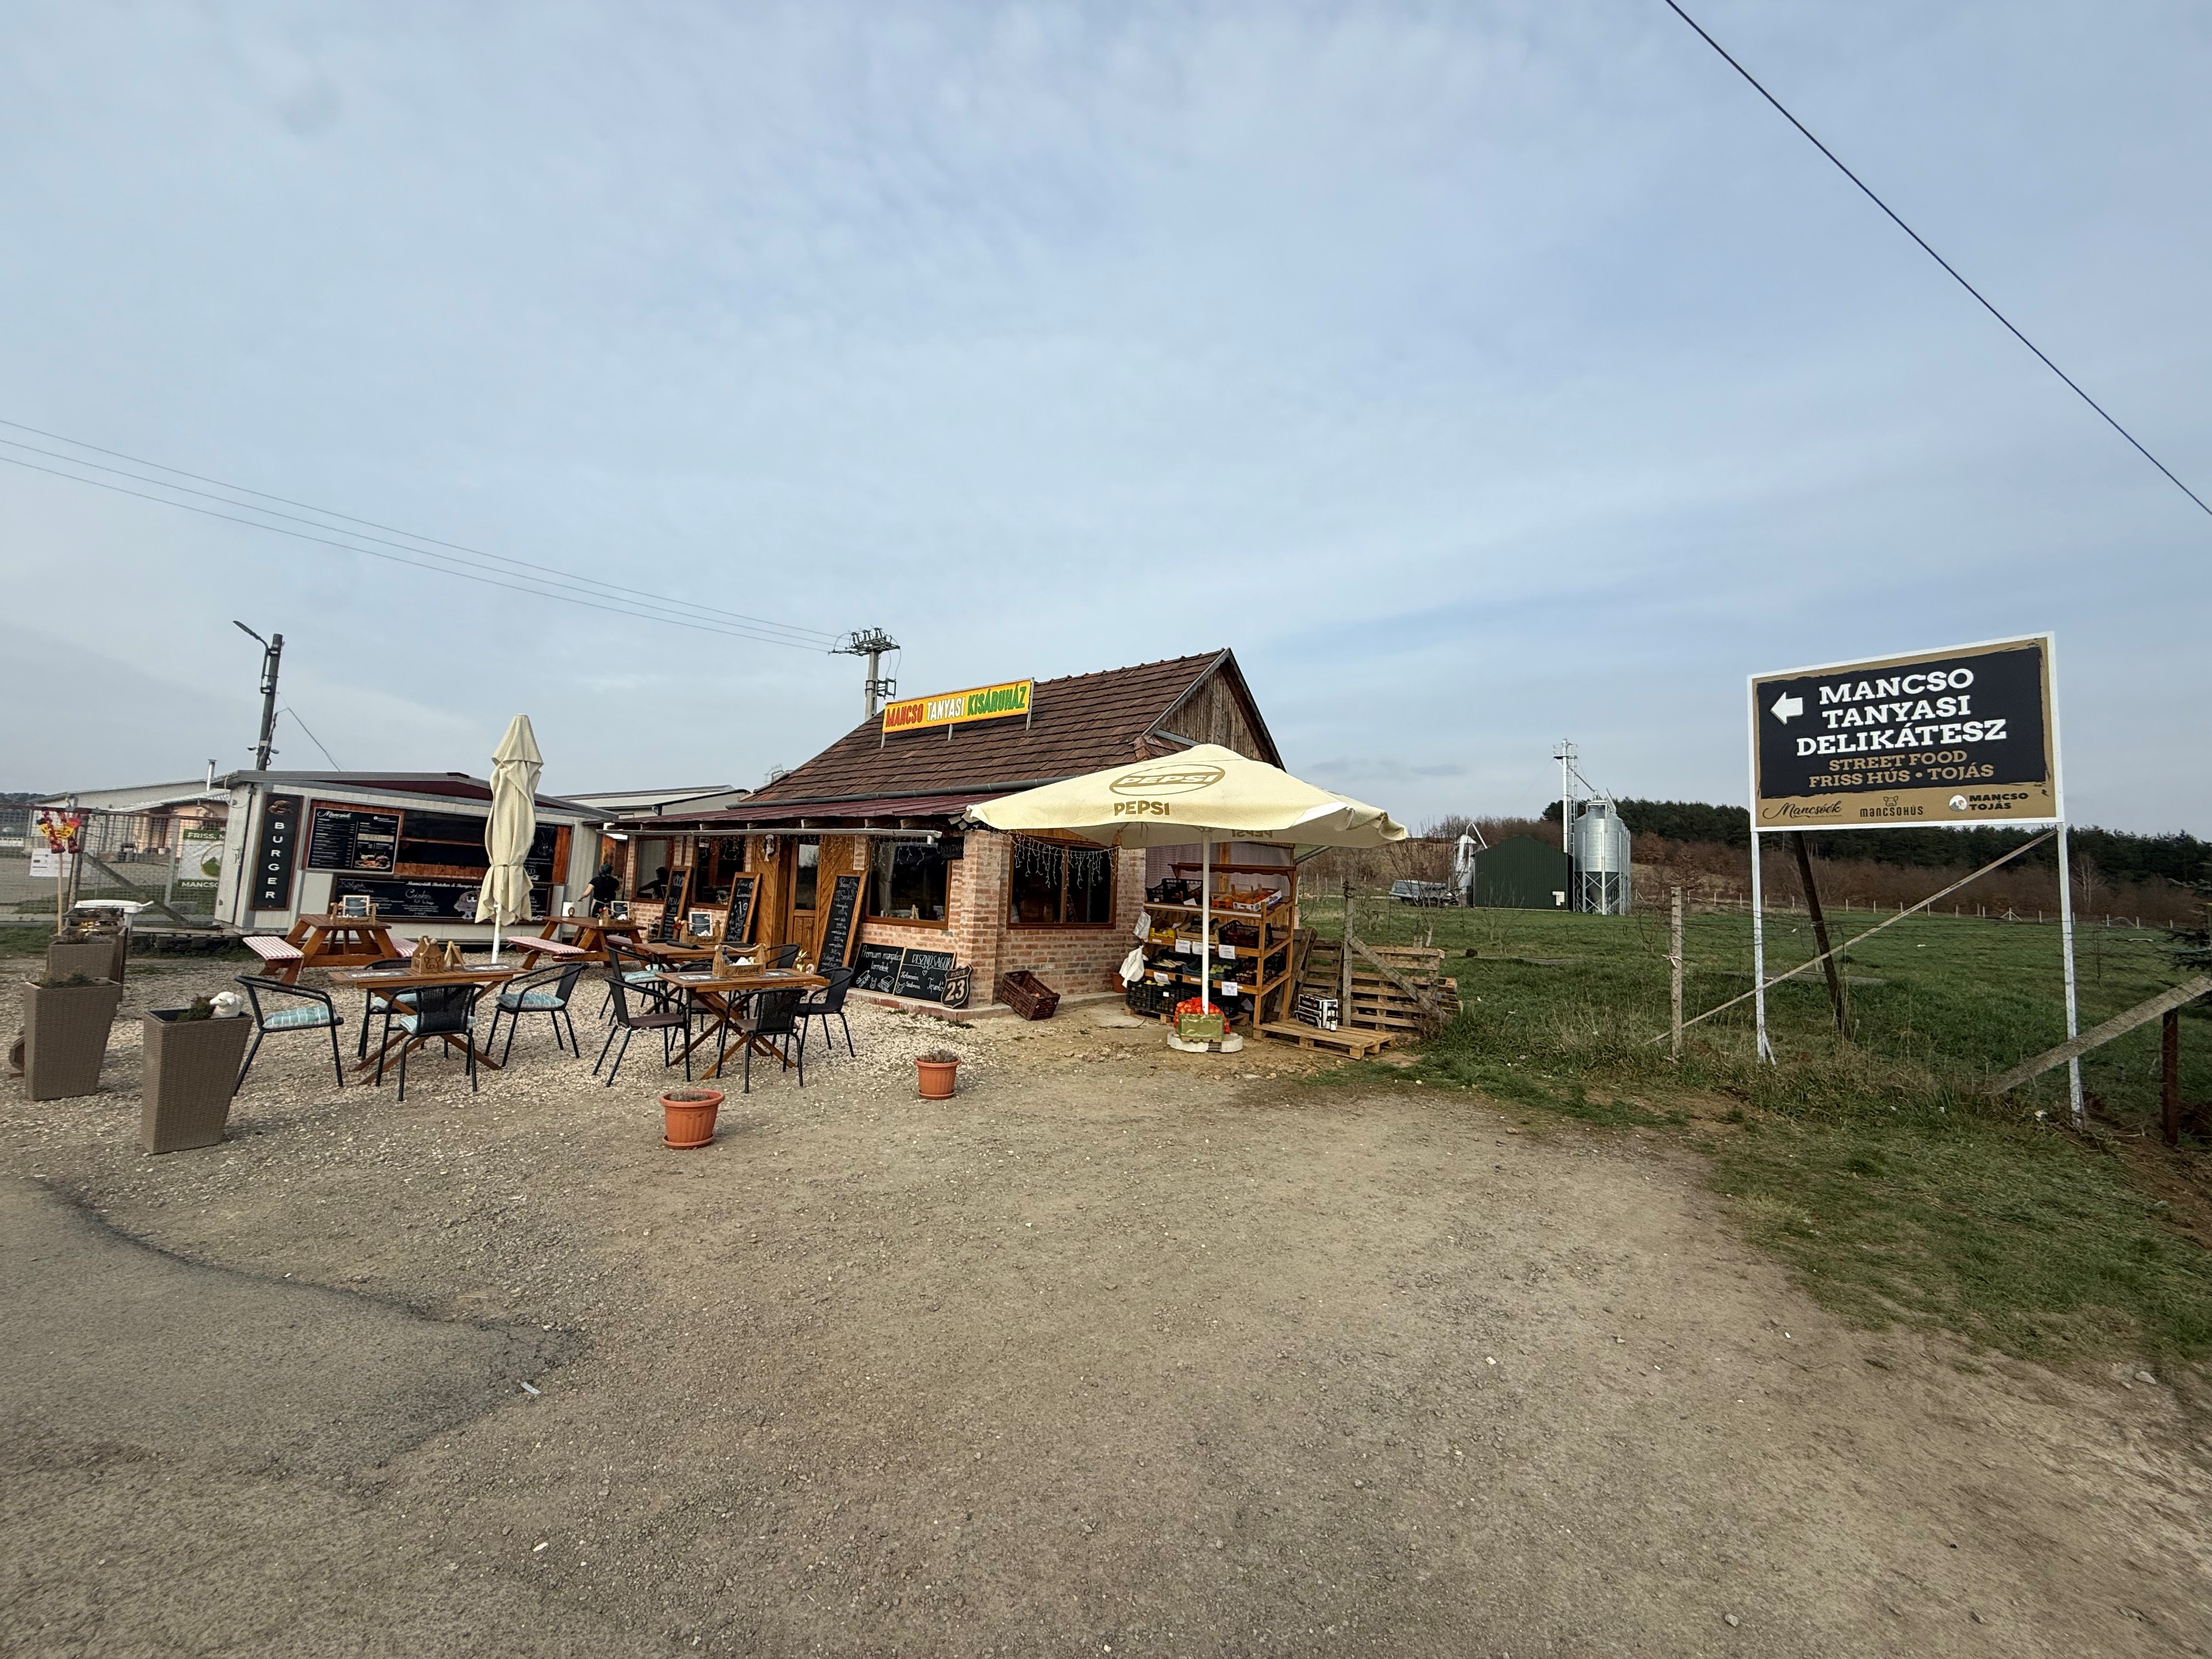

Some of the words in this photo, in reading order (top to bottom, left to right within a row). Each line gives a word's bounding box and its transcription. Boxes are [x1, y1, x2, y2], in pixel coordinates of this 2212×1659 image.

[1819, 668, 1974, 705] MANCSO
[885, 703, 923, 727] MANCSO
[927, 697, 966, 721] TANYASI
[967, 684, 1026, 716] KISÁRUHÁZ
[1822, 695, 1972, 729] TANYASI
[1796, 719, 2007, 756] DELIKÁTESZ
[1829, 754, 1906, 771] STREET
[1909, 750, 1967, 765] FOOD
[1117, 774, 1219, 785] PEPSI
[1809, 773, 1863, 788] FRISS
[1866, 769, 1911, 784] HÚS
[1927, 763, 1994, 780] TOJÁS
[1114, 800, 1170, 816] PEPSI
[1969, 793, 2028, 802] MANCSO
[1969, 801, 2011, 810] TOJÁS
[265, 822, 285, 899] BURGER
[945, 979, 965, 1001] 23
